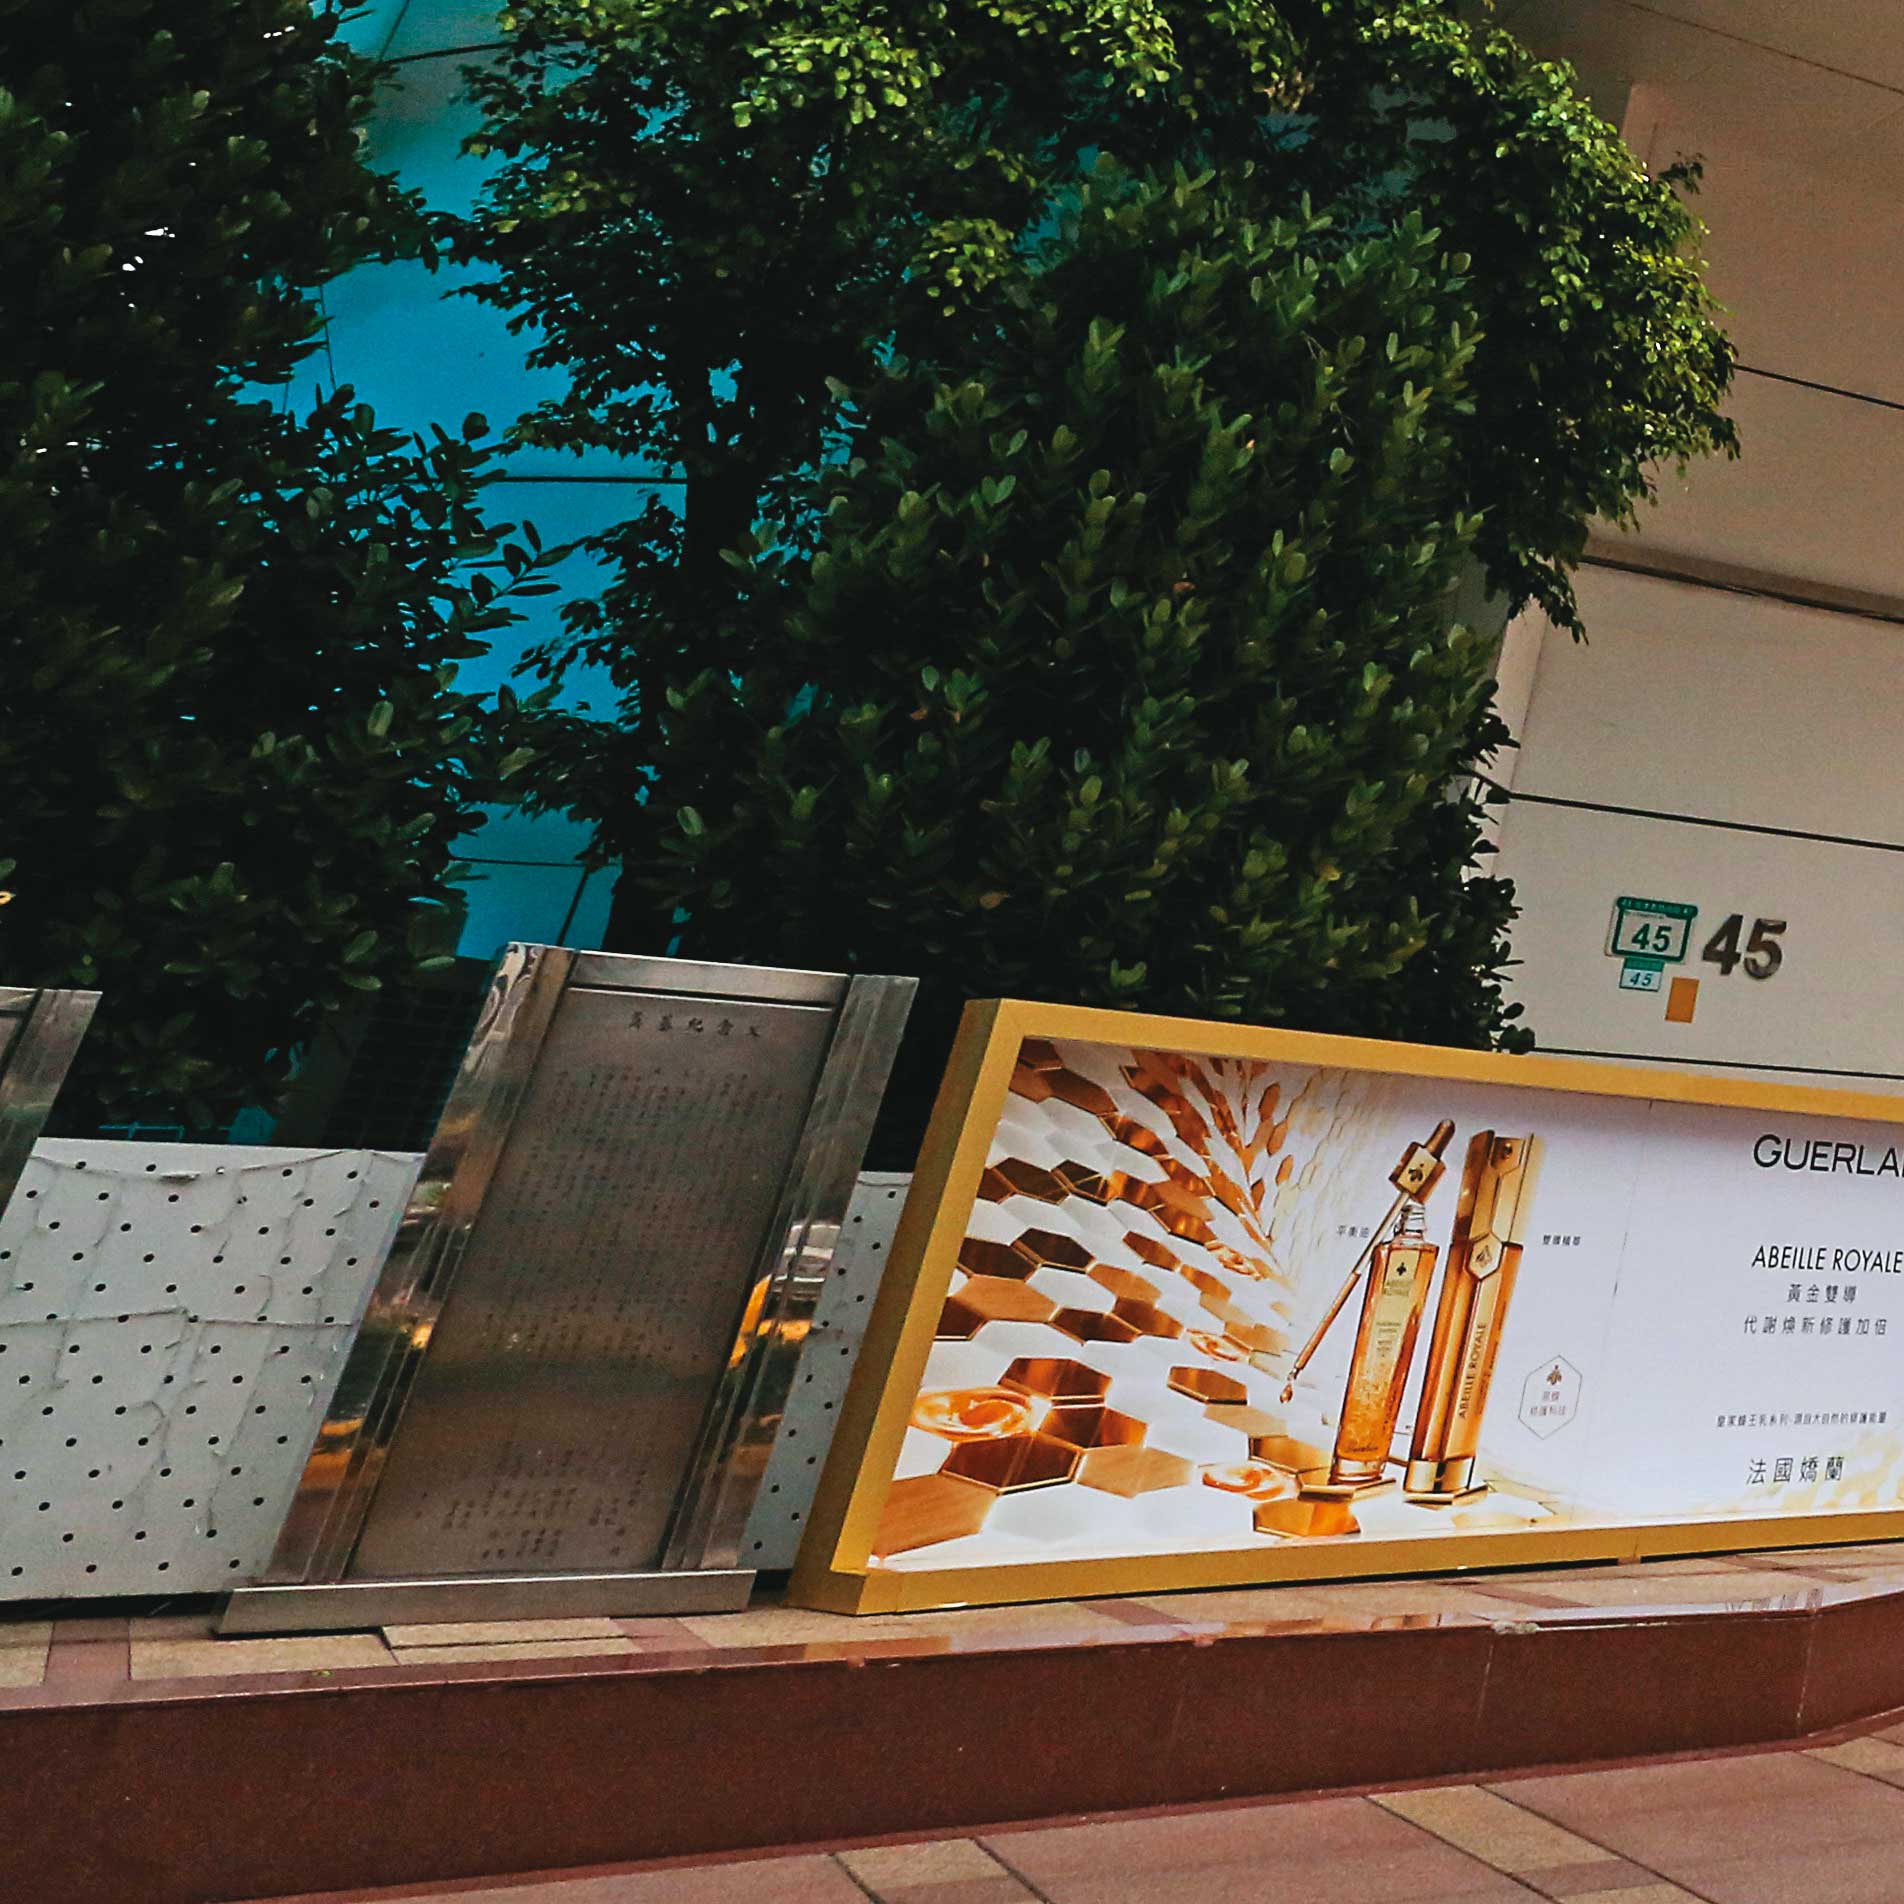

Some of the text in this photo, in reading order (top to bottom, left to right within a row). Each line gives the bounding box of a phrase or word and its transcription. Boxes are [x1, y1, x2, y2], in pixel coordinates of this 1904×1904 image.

[1632, 923, 1673, 952] 45
[1703, 914, 1787, 979] 45
[1630, 972, 1652, 987] 45
[1751, 1245, 1904, 1274] ABEILLE ROYALE
[1787, 1283, 1858, 1305] 黃金雙導
[1743, 1315, 1888, 1337] 代謝煥新修護加倍
[1745, 1456, 1846, 1486] 法國嬌蘭
